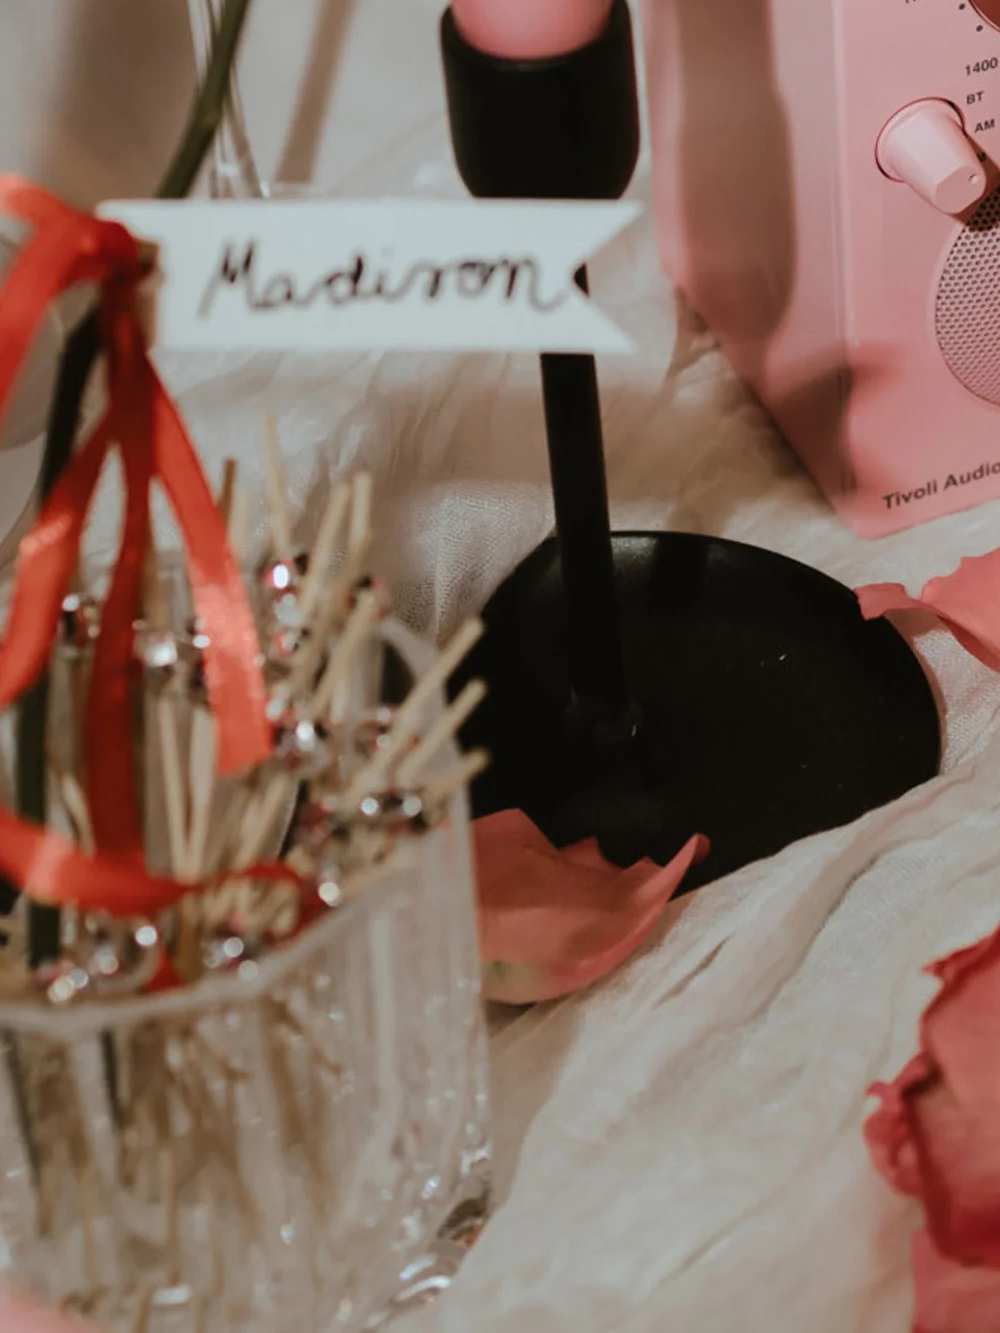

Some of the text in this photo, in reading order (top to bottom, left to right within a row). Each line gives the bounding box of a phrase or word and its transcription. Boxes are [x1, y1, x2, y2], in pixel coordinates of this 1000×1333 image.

[965, 56, 999, 76] 1400
[966, 90, 984, 105] BT
[974, 118, 995, 134] AM
[198, 239, 567, 321] Madison
[882, 480, 938, 510] Tivoli
